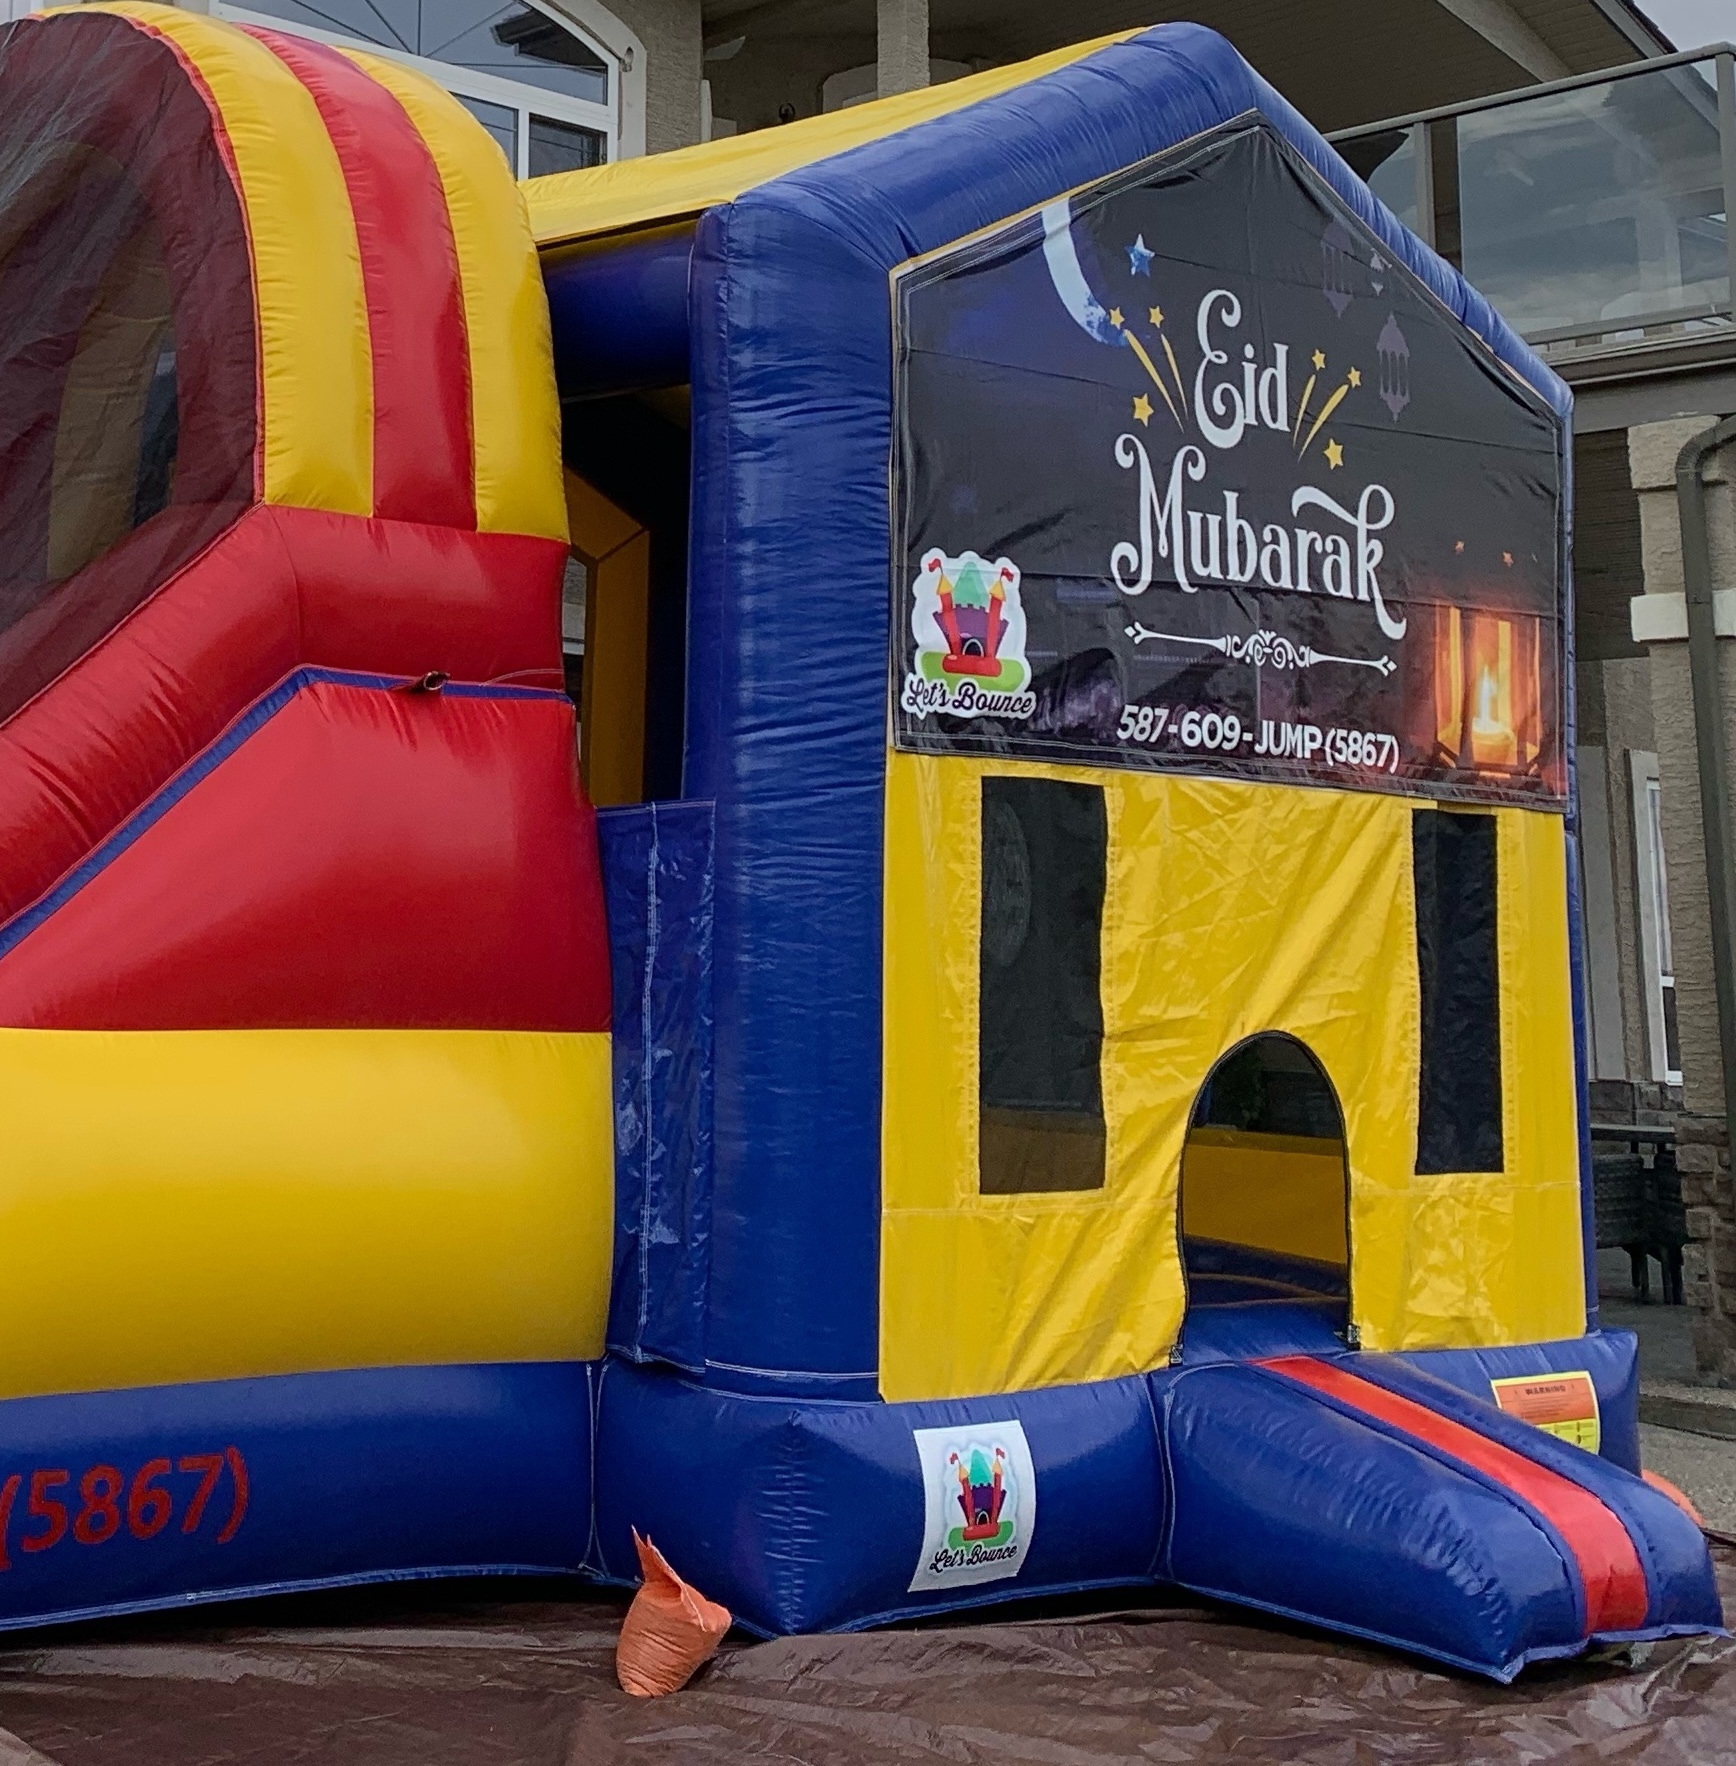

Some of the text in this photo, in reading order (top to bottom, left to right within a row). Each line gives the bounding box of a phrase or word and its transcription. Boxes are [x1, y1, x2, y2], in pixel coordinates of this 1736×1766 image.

[1194, 289, 1292, 449] Eid
[1110, 433, 1407, 640] Mubarak
[906, 677, 1033, 713] Let's Bounce
[1525, 1385, 1566, 1395] WARNING
[929, 1544, 1018, 1574] Let's Bounce
